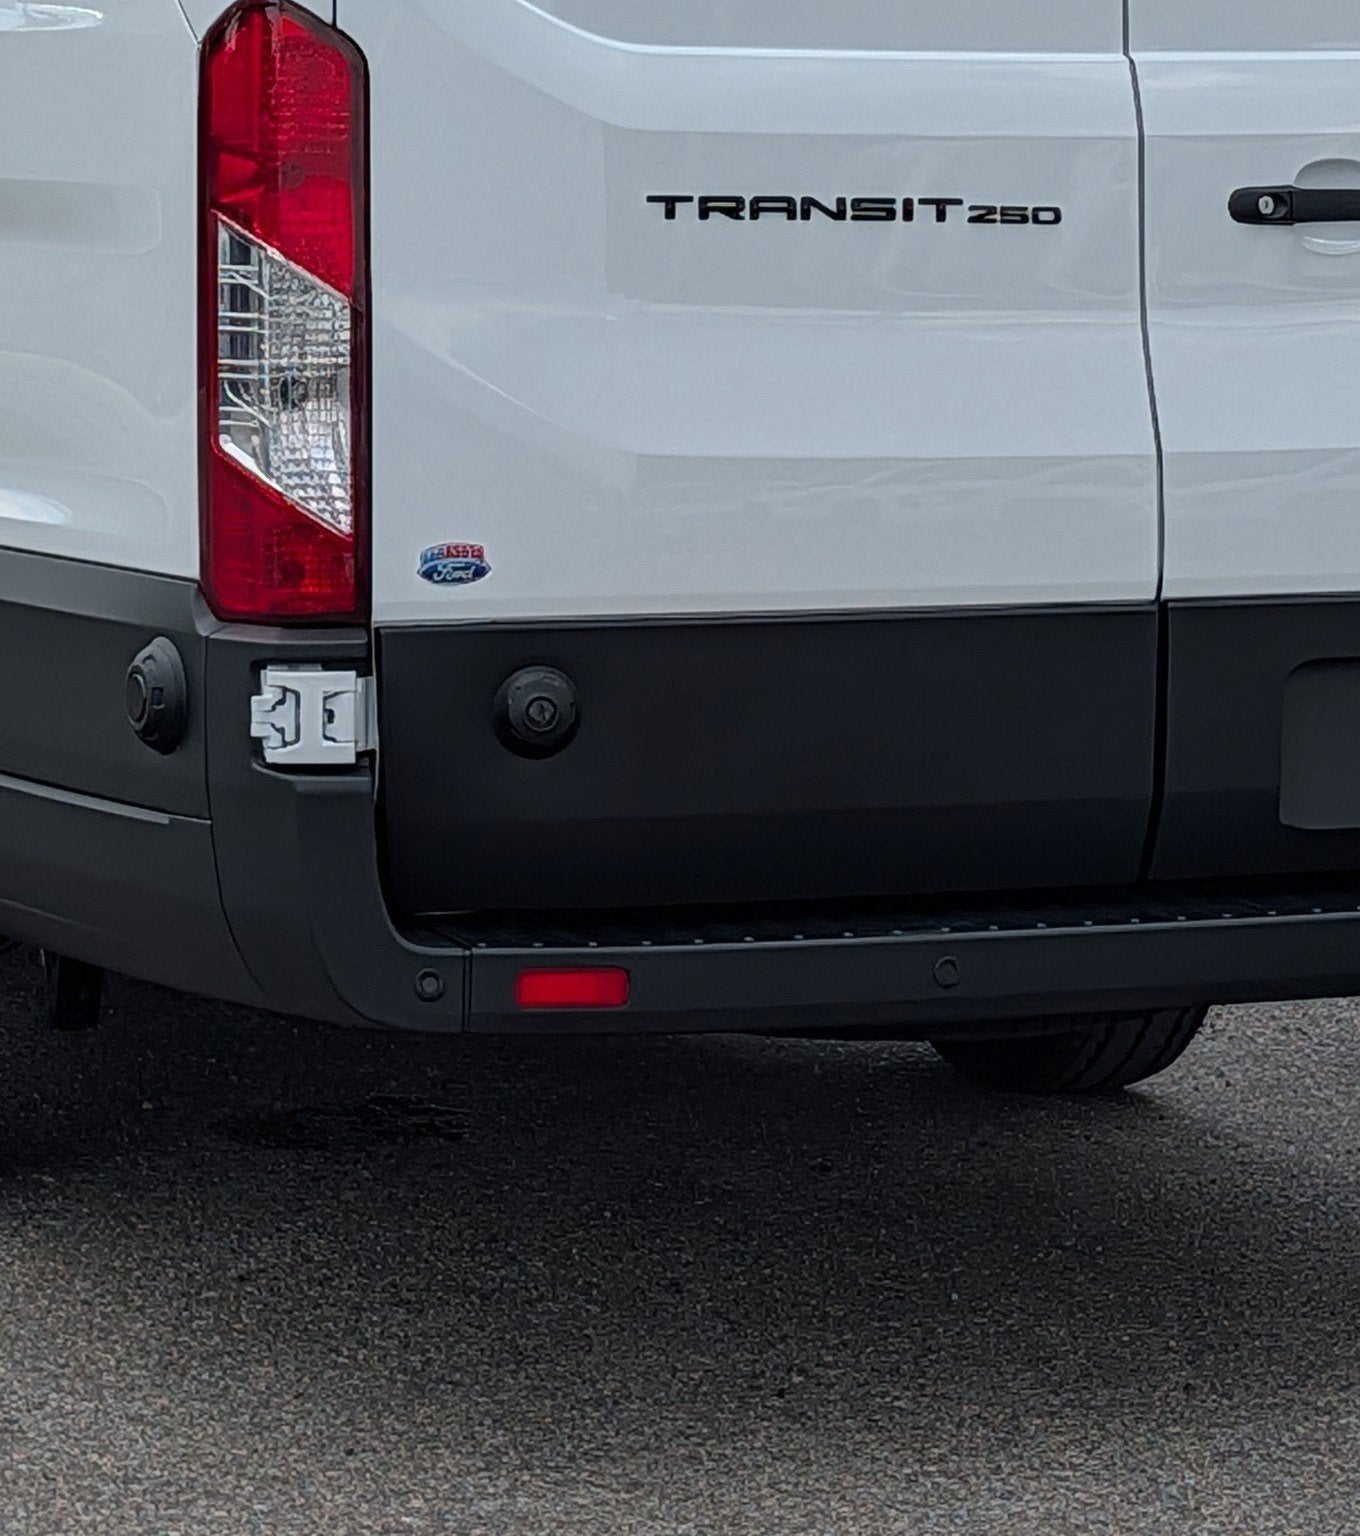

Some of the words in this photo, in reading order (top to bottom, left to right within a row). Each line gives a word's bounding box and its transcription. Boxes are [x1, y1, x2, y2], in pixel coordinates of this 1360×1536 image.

[645, 195, 965, 223] TRANSIT
[966, 204, 1063, 226] 250
[432, 563, 476, 582] Ford
